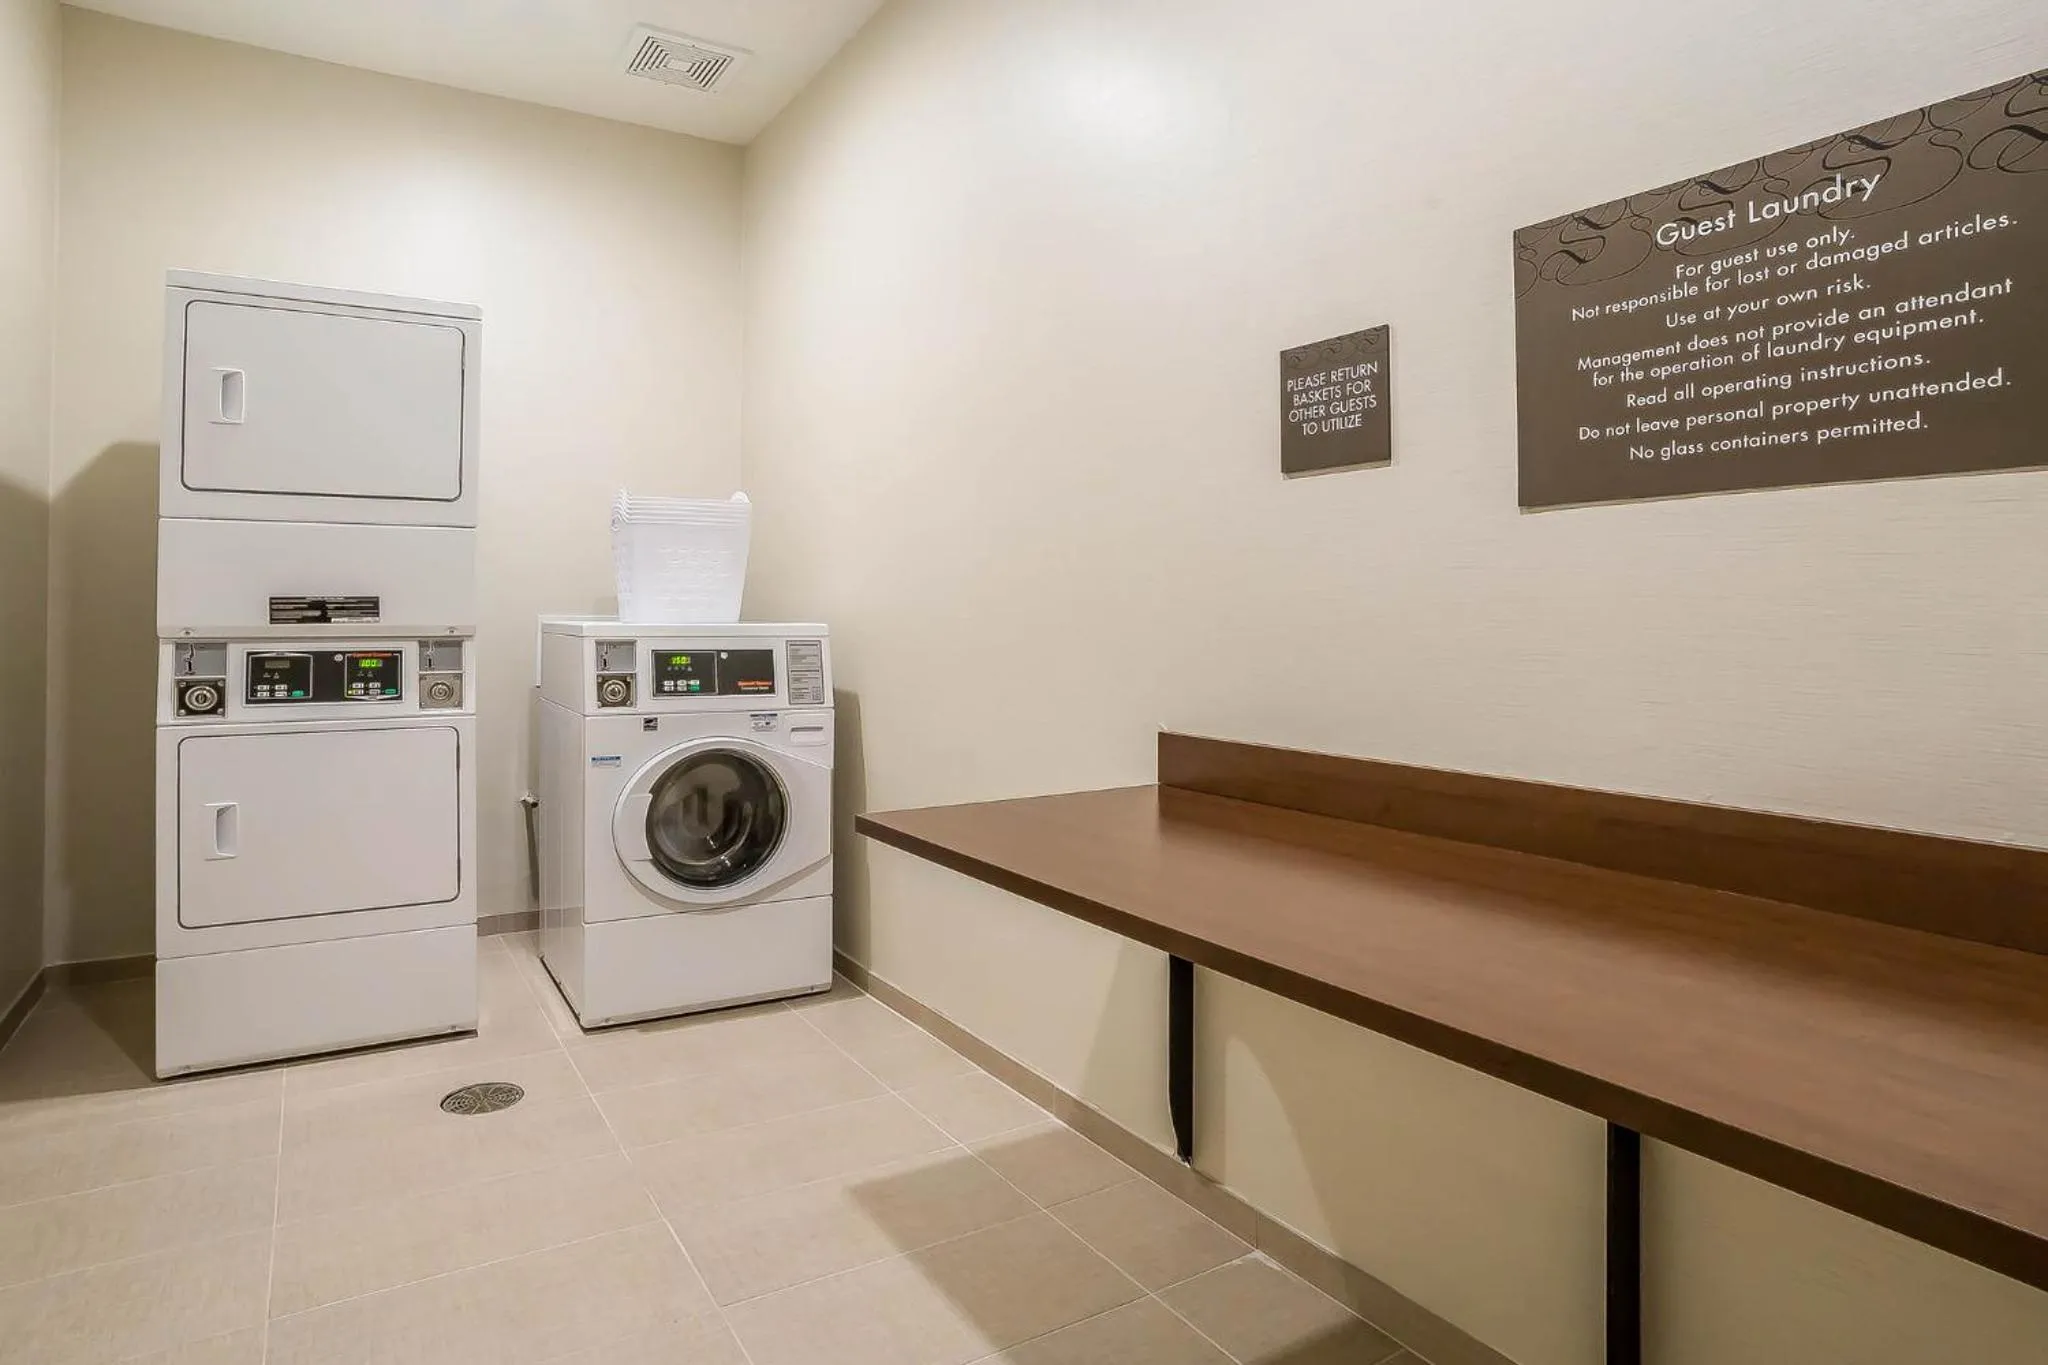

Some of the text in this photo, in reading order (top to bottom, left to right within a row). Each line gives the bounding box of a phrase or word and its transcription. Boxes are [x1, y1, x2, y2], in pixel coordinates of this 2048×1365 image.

[1656, 173, 1880, 245] Guest Laundry
[1572, 214, 2017, 321] Not responsible for lost or damaged articles.
[1676, 226, 1854, 279] For guest use only.
[1578, 279, 2012, 370] Management does not provide an attendant
[1667, 273, 1870, 327] Use at your own risk.
[1593, 310, 1983, 386] for the operation of laundry equipment.
[1288, 361, 1377, 391] PLEASE RETURN
[1294, 379, 1371, 406] BASKETS FOR
[1627, 355, 1930, 407] Read all operating instructions.
[1289, 395, 1376, 422] OTHER GUESTS
[1303, 413, 1361, 435] TO UTILIZE
[1580, 368, 2010, 440] Do not leave personal property unattended.
[1630, 411, 1927, 460] No glass containers permitted.
